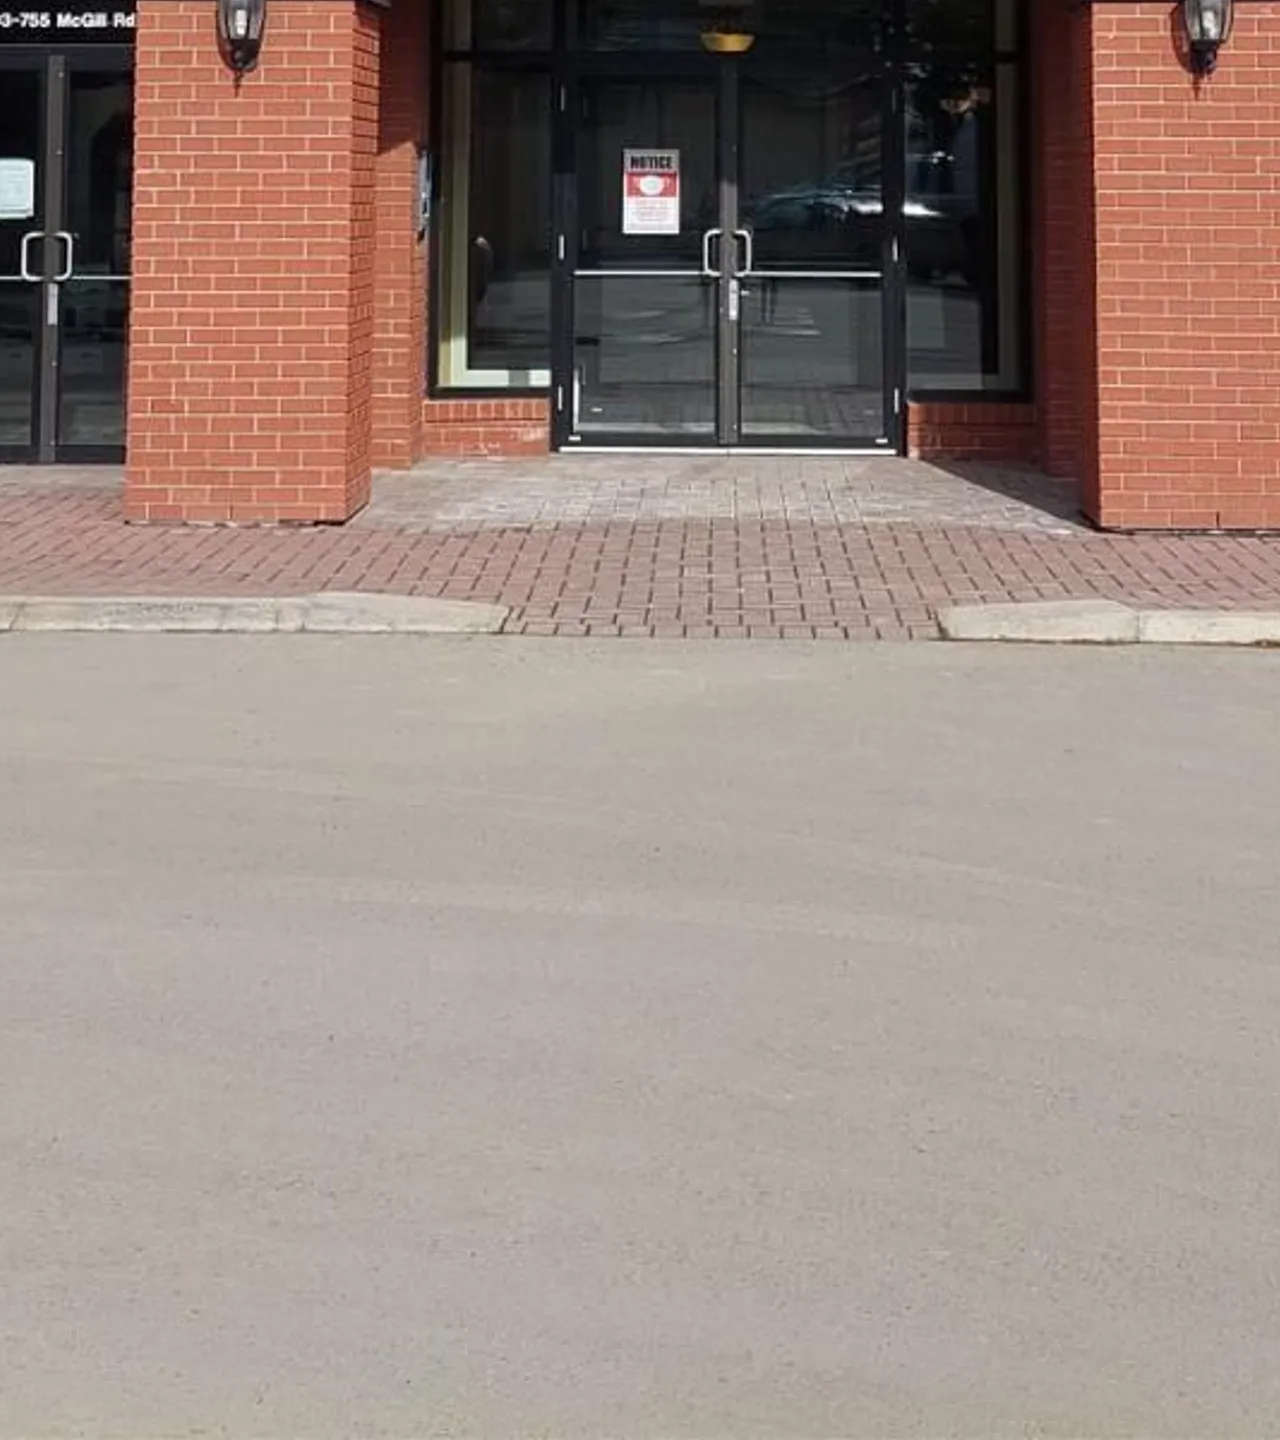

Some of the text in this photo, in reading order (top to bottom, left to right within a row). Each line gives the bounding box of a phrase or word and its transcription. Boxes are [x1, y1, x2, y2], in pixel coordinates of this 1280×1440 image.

[56, 12, 108, 28] McGill
[113, 12, 135, 28] Rd
[630, 155, 673, 169] NOTICE
